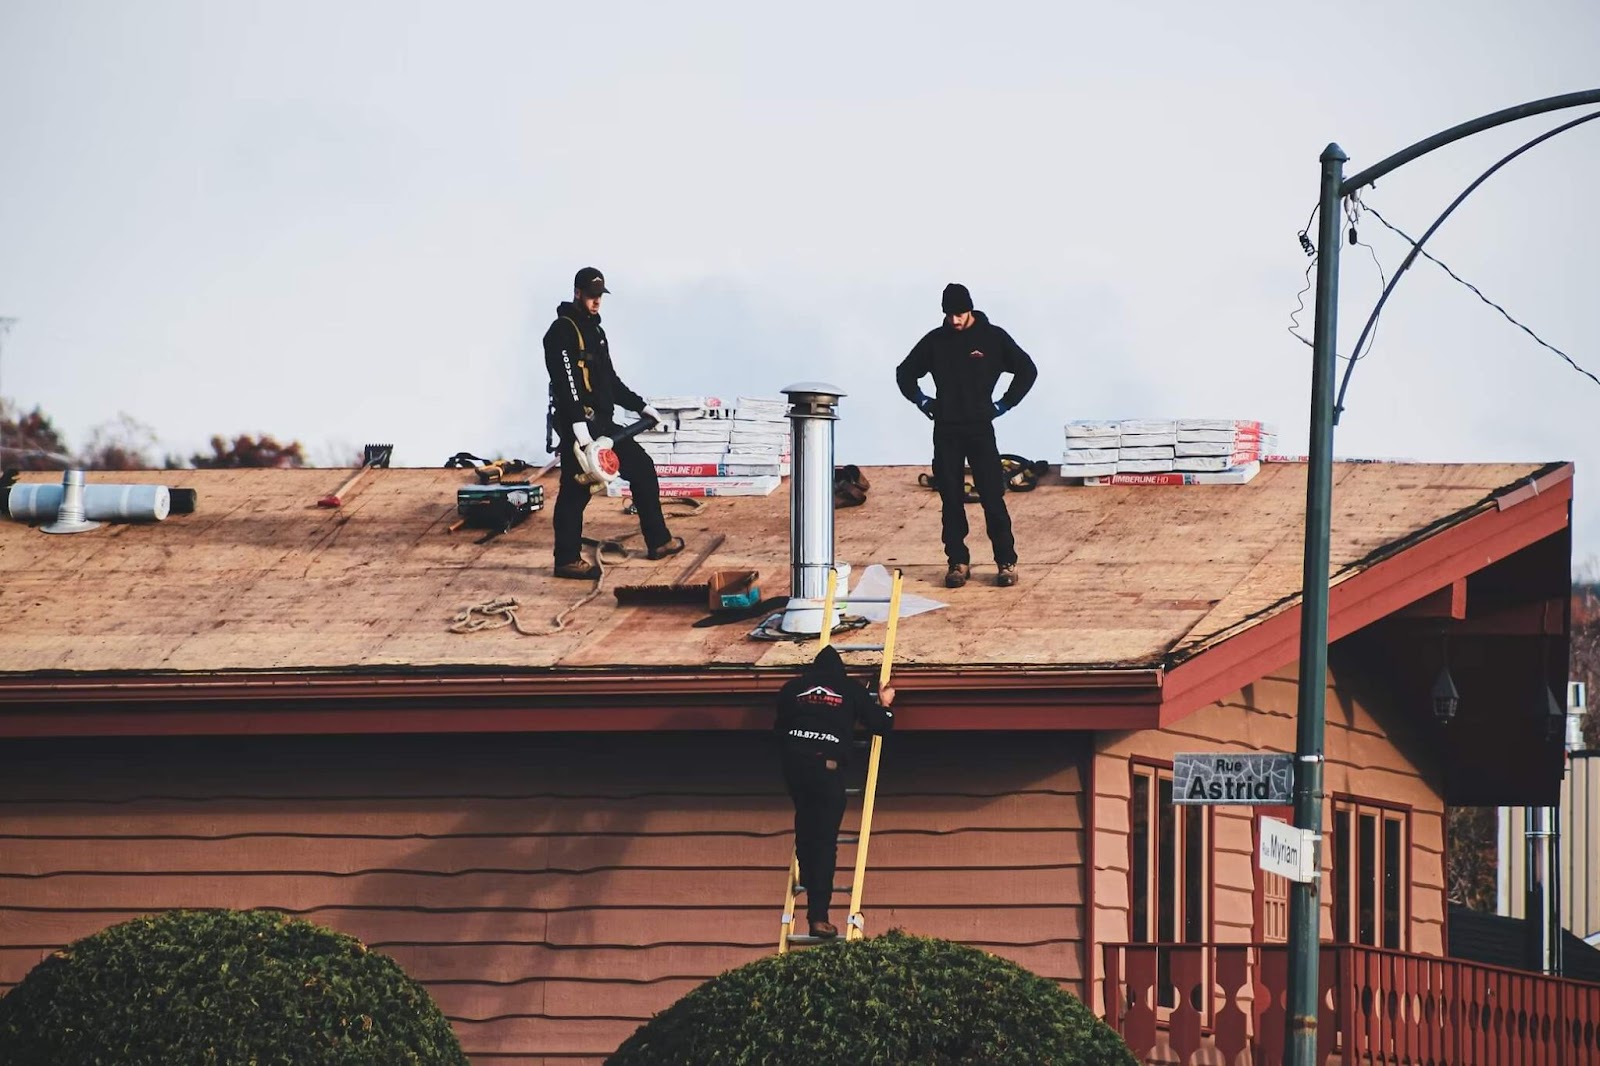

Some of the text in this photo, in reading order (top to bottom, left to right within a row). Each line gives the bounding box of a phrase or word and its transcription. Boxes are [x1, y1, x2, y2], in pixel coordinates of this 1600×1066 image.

[562, 350, 579, 401] COUVREUR
[655, 465, 703, 475] MBERLINE HD
[1112, 474, 1156, 484] TIMBERLINE
[1156, 475, 1169, 484] HD
[1216, 759, 1242, 772] Rue
[1188, 776, 1270, 799] Astrid
[1270, 834, 1298, 866] Myriam
